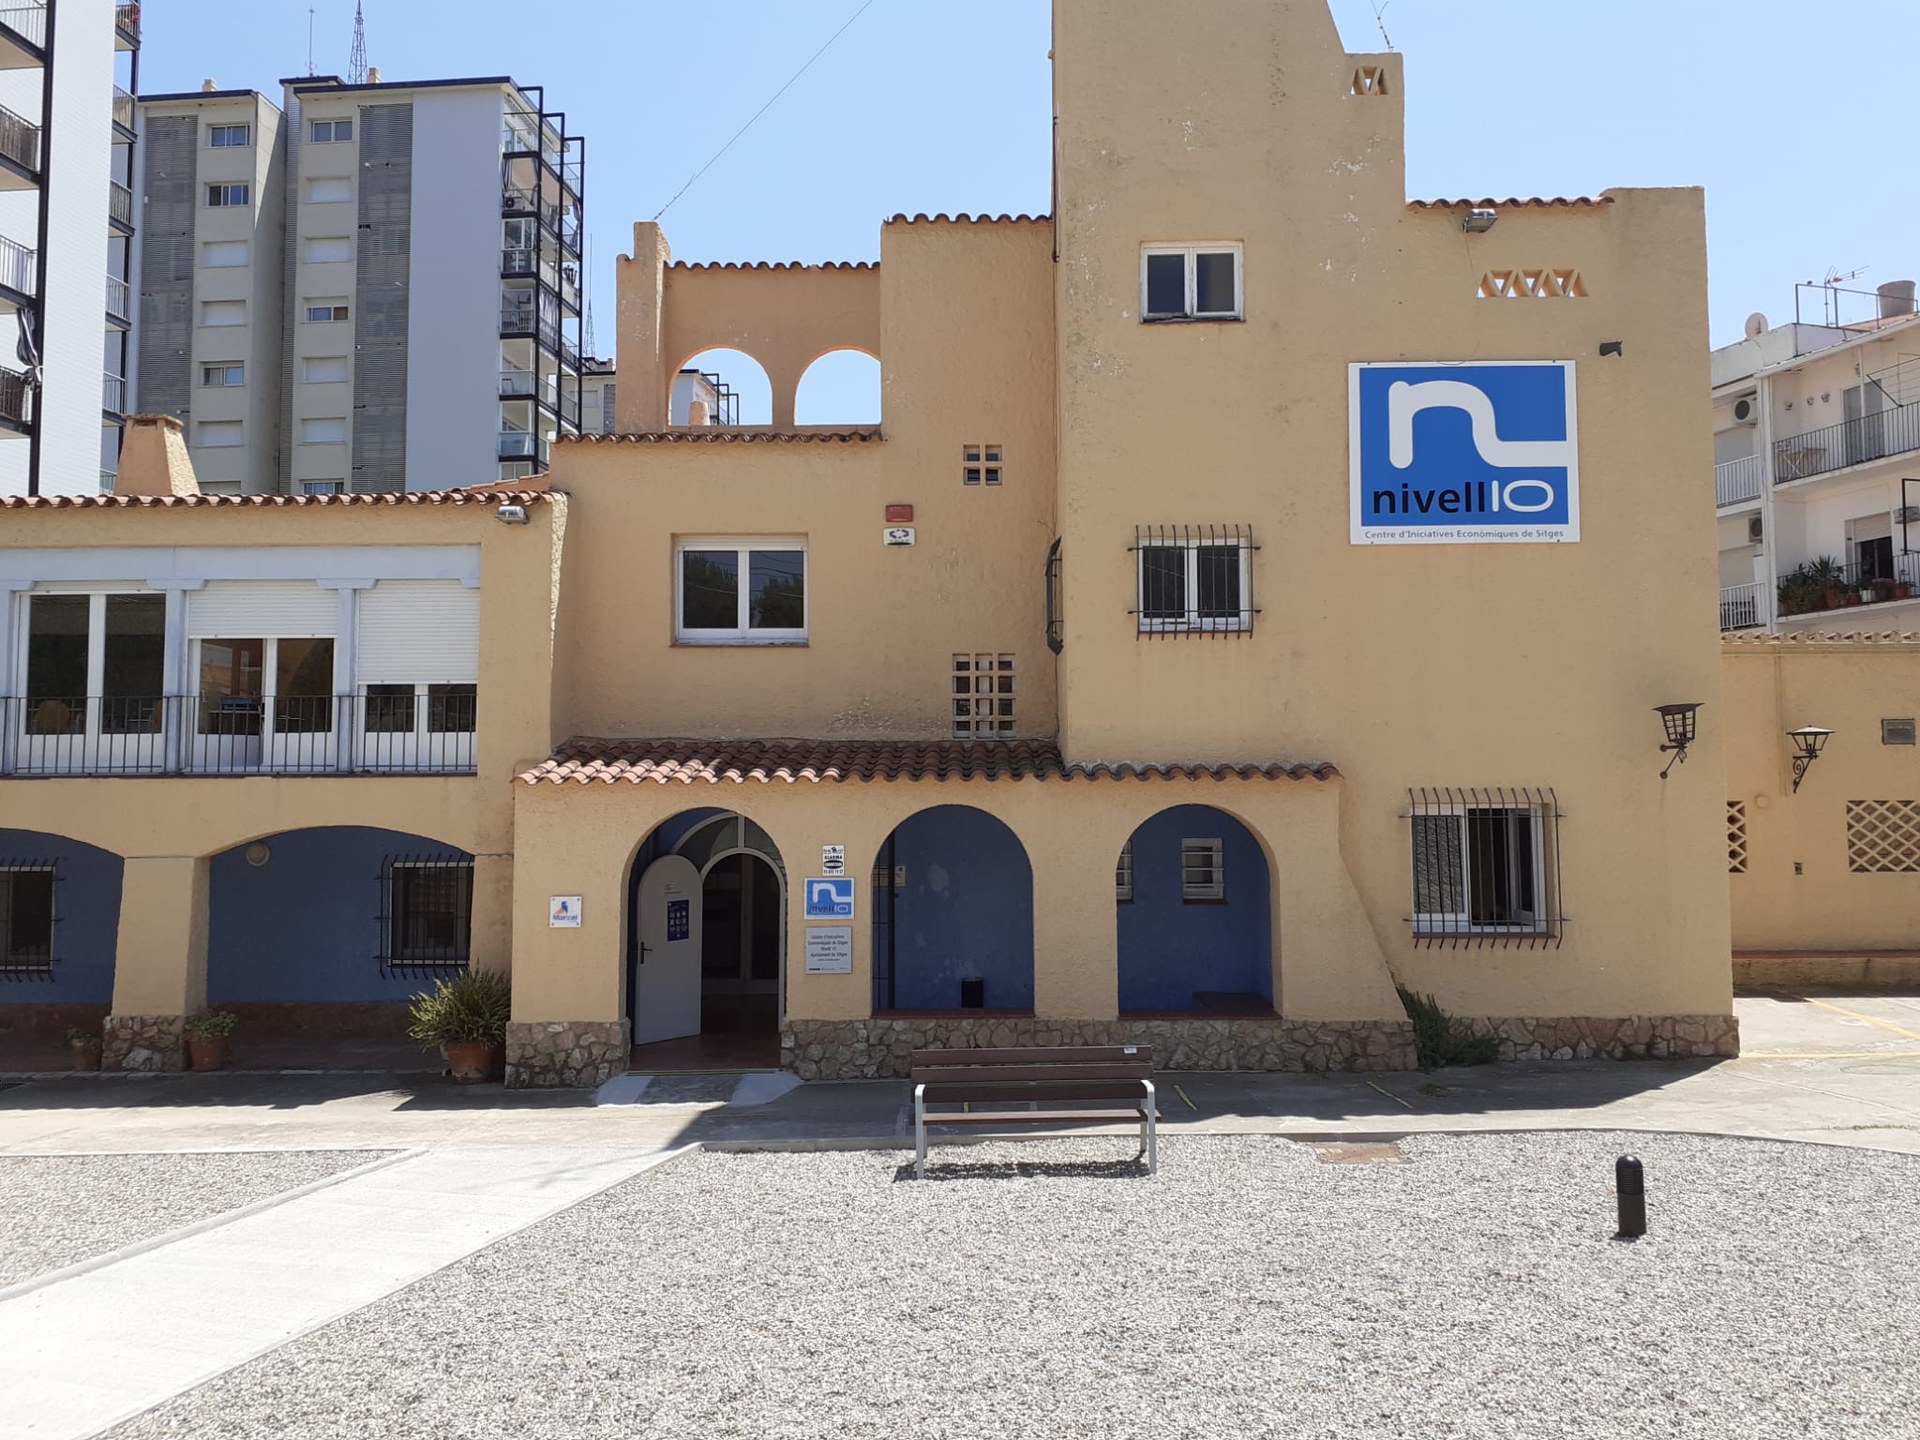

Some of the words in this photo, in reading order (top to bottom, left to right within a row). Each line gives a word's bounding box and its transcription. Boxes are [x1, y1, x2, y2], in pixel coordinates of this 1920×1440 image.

[1364, 530, 1396, 539] Centre
[1398, 529, 1454, 539] d'Iniciatives
[1456, 529, 1519, 539] Econòmiques
[1521, 529, 1533, 538] de
[1536, 529, 1564, 539] Sitges
